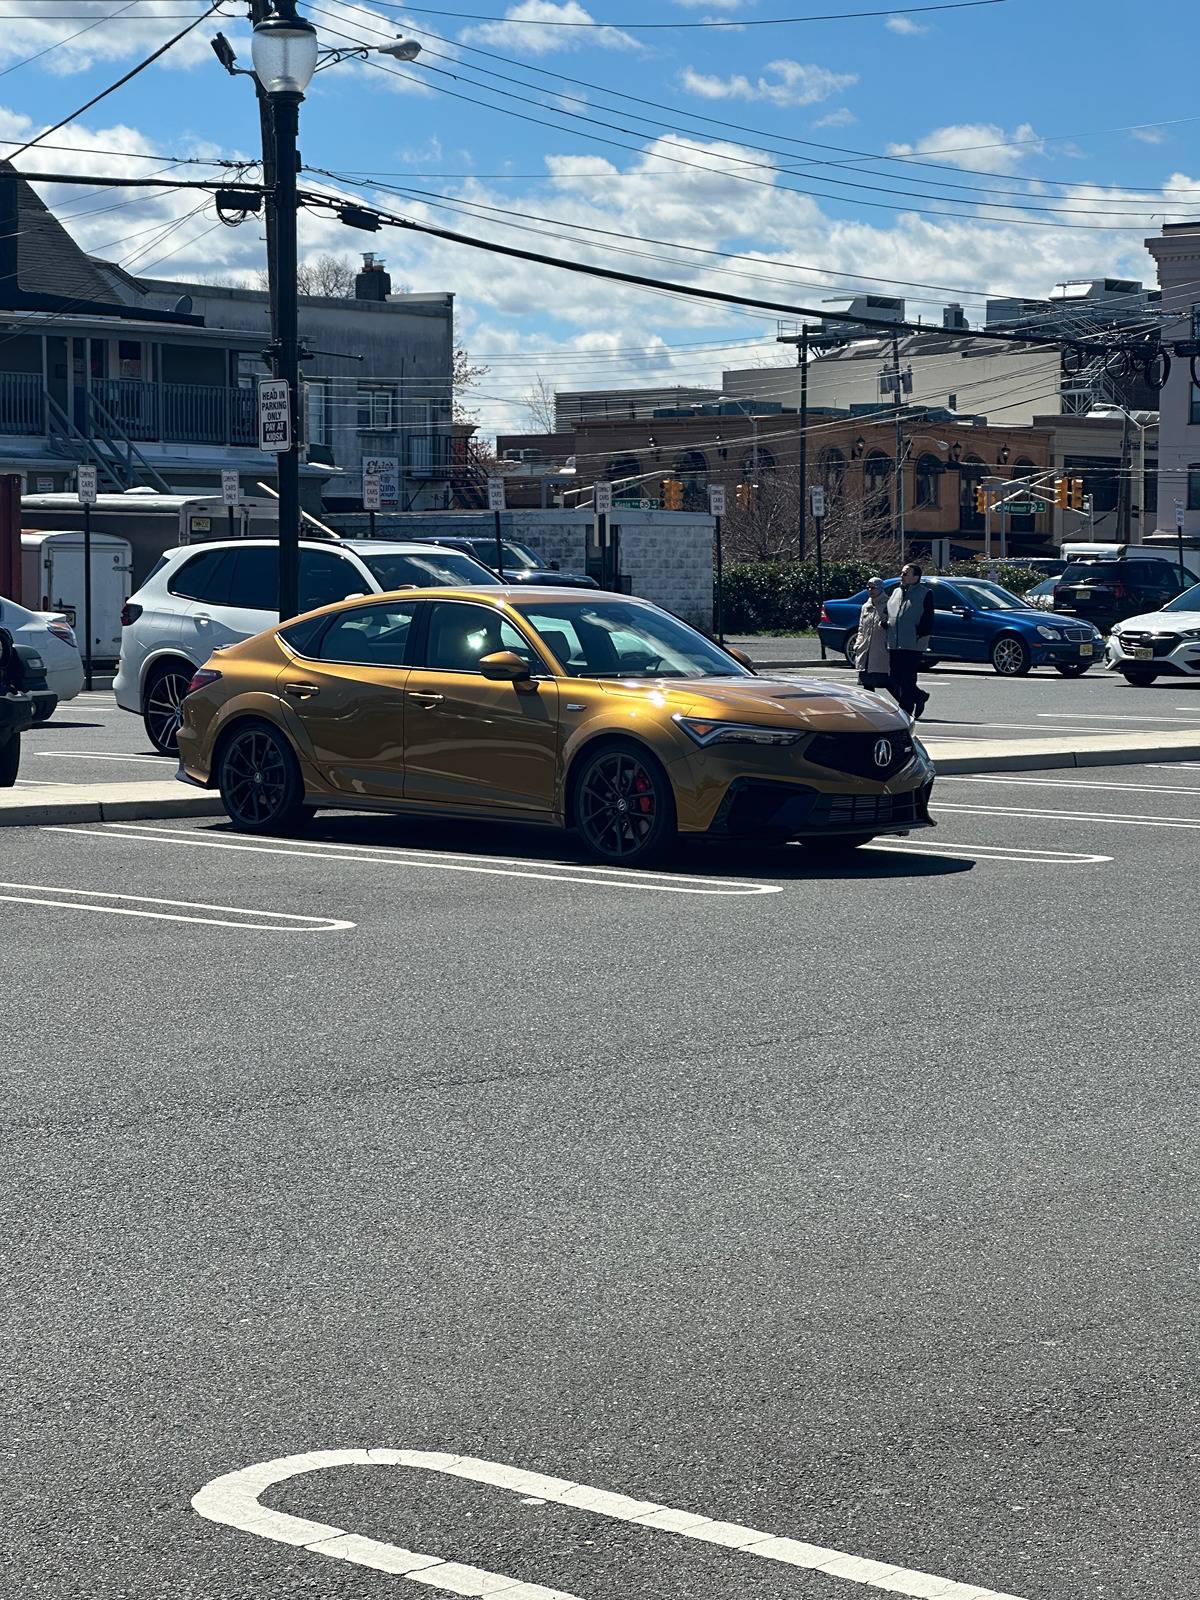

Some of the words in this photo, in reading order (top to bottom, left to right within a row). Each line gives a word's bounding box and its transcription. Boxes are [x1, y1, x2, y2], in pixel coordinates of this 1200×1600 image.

[262, 391, 277, 400] HEAD
[279, 390, 285, 399] IN
[262, 401, 287, 411] PARKING
[267, 412, 281, 421] ONLY
[265, 422, 275, 432] PAY
[277, 422, 284, 431] AT
[265, 432, 284, 441] KIOSK
